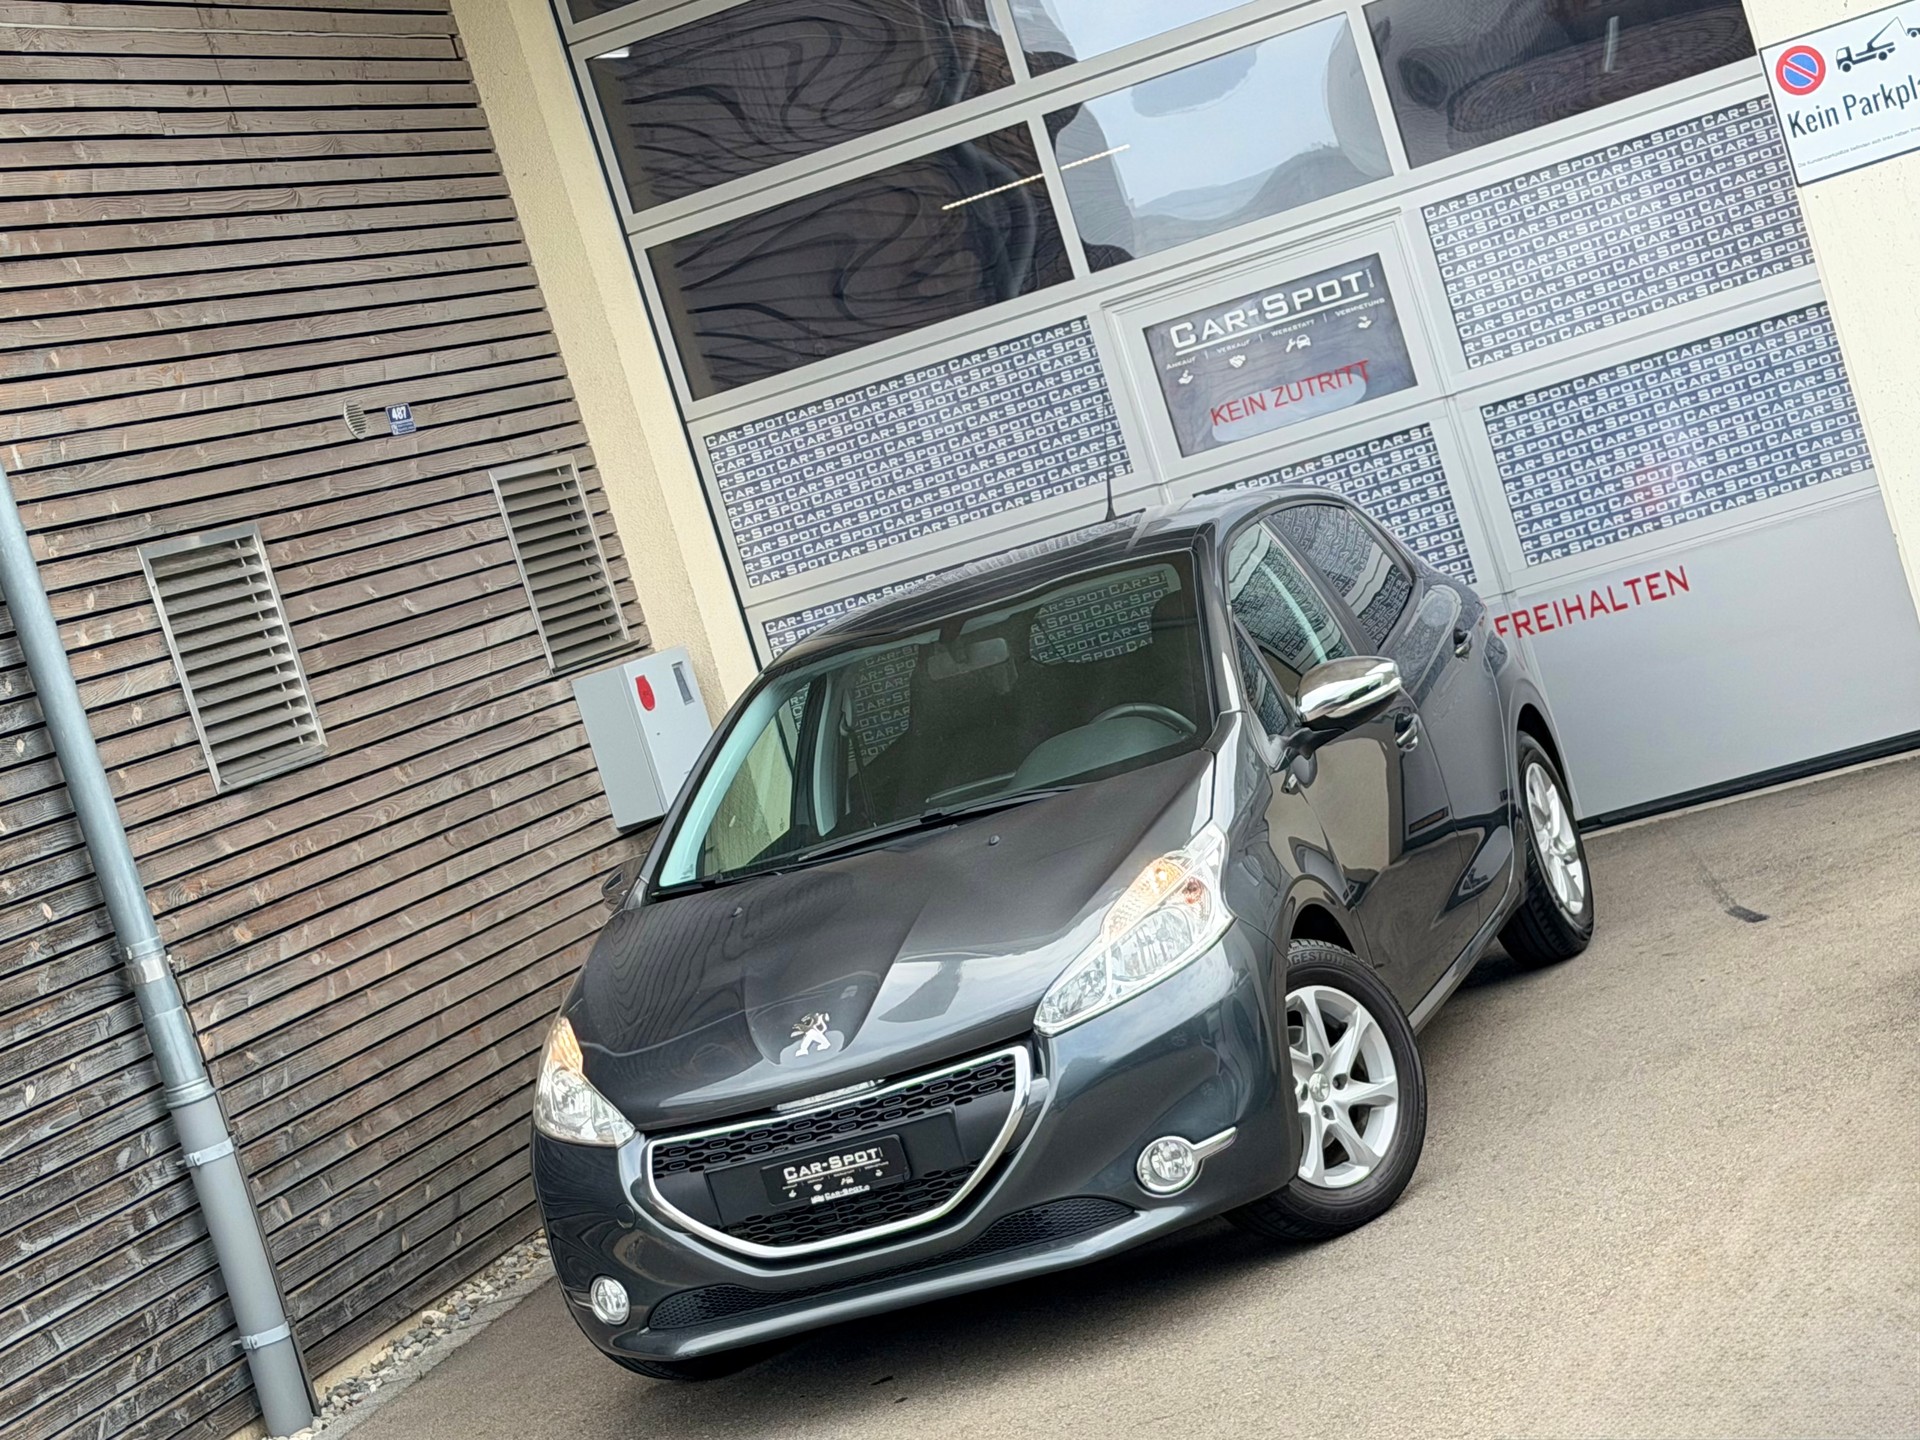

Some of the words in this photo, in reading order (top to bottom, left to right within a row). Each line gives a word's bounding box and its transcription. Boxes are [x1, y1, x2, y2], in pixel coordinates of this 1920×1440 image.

[1787, 105, 1839, 138] Kein
[1843, 75, 1920, 121] Parkpl
[1170, 271, 1363, 348] CAR-SPOT
[1210, 393, 1267, 426] KEIN
[1270, 360, 1369, 409] ZUTRITT
[1494, 565, 1690, 638] FREIHALTEN
[783, 1148, 878, 1180] CAR-SPOT
